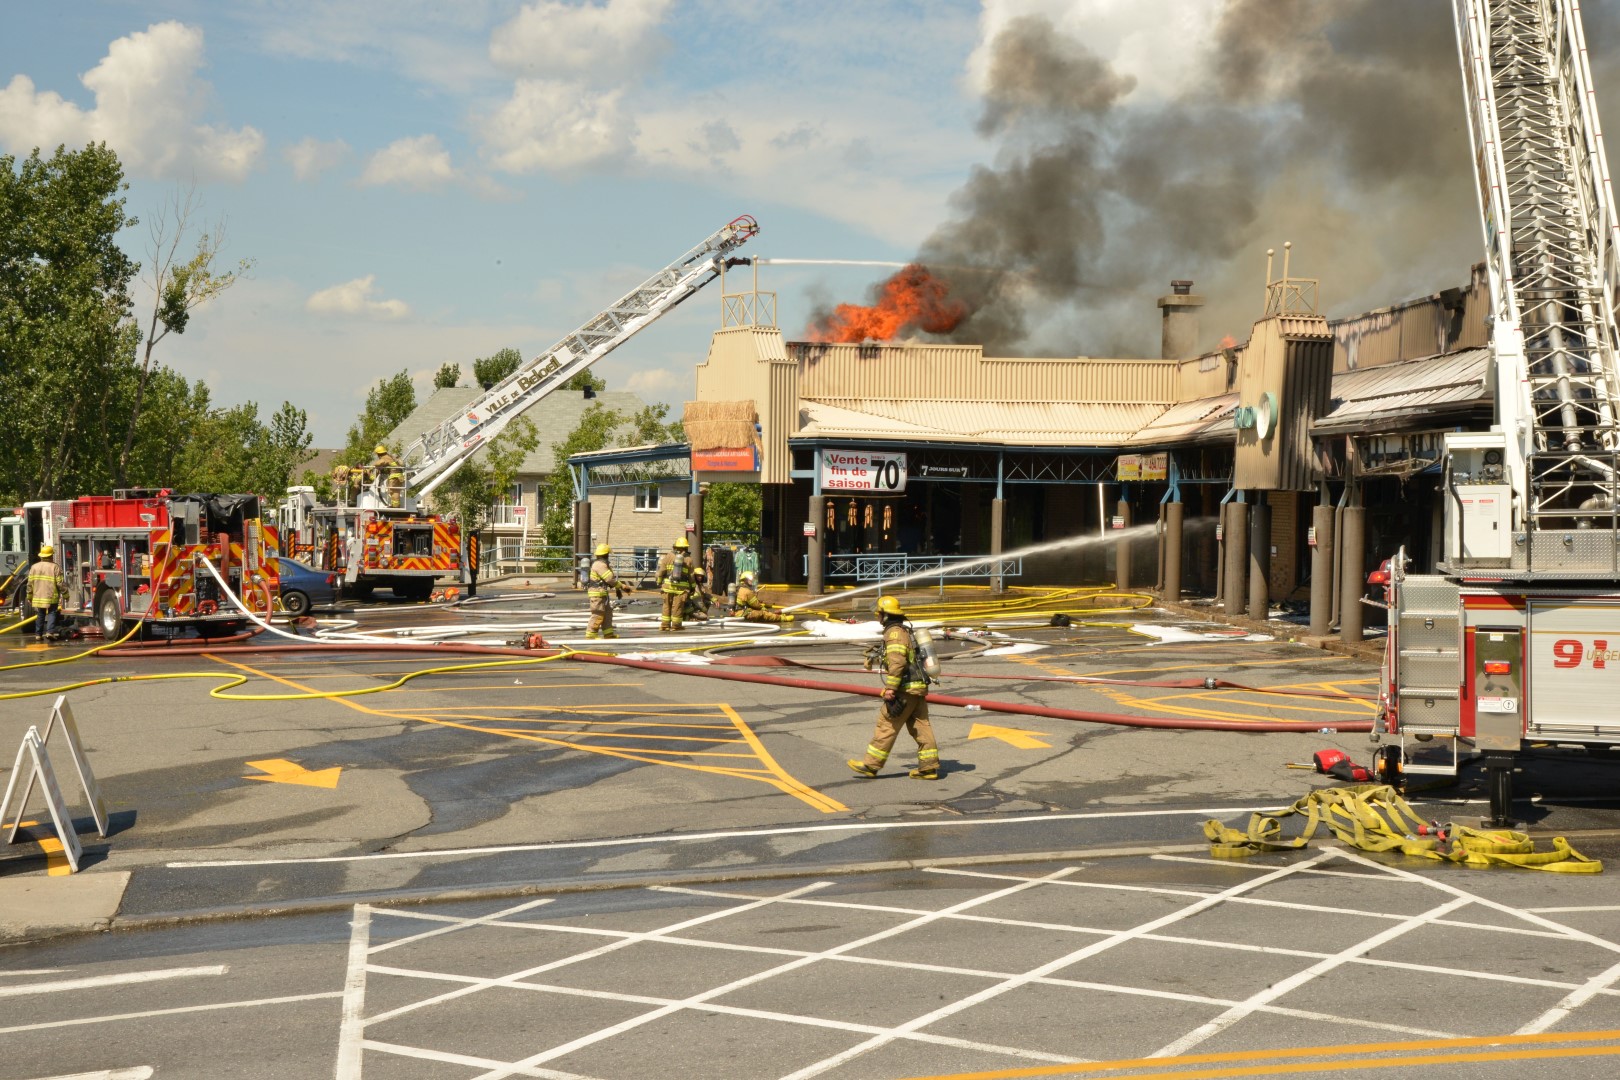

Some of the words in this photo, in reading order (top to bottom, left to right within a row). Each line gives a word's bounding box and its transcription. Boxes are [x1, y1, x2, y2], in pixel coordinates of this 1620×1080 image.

[486, 395, 509, 413] VILLE
[510, 391, 519, 399] DE
[830, 454, 868, 465] Vente
[831, 465, 849, 476] fin
[851, 466, 867, 477] de
[921, 465, 928, 476] 7
[961, 467, 968, 478] 7
[828, 478, 871, 489] saison
[1586, 650, 1620, 661] URGE
